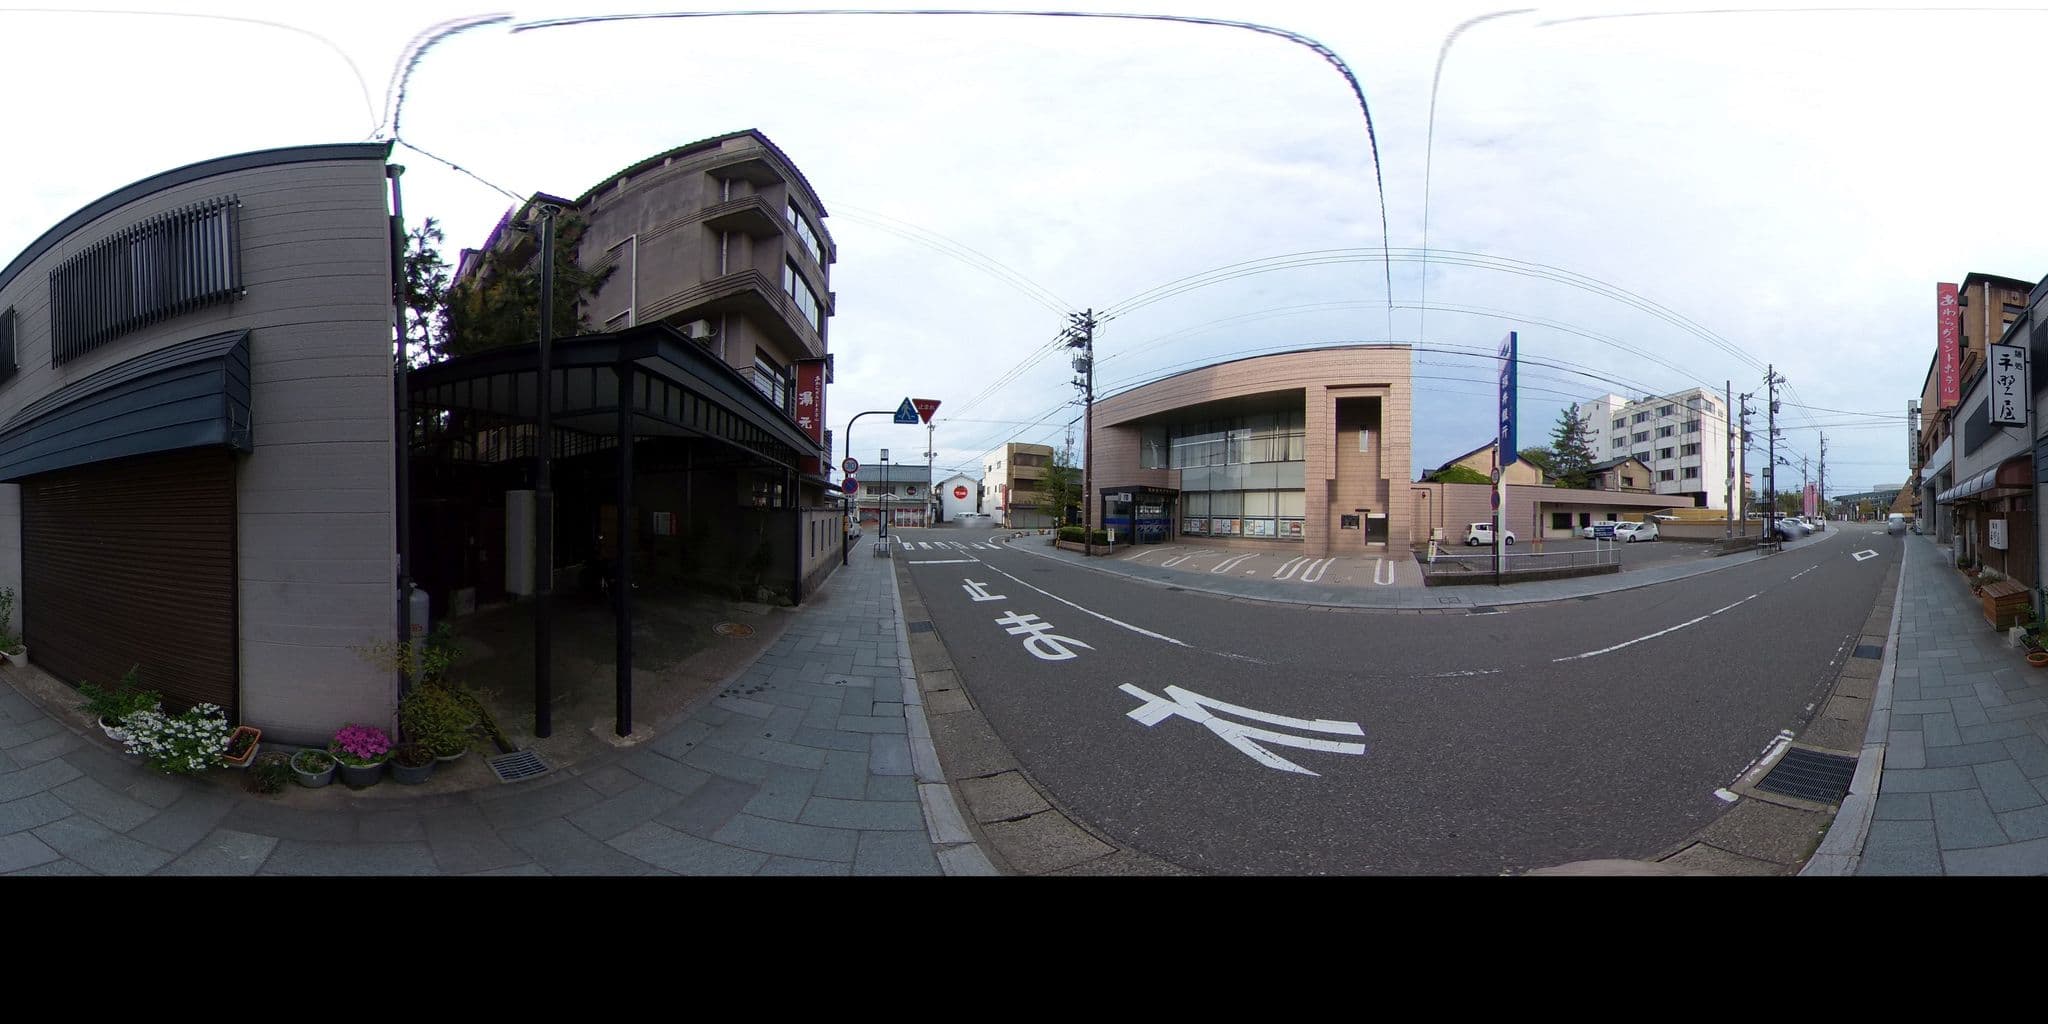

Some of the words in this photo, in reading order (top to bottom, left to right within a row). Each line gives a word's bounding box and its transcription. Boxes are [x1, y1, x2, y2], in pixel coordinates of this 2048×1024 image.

[1940, 294, 1957, 394] あわらグランドホテル
[799, 391, 813, 429] 湯元
[962, 578, 1367, 777] 止まれ
